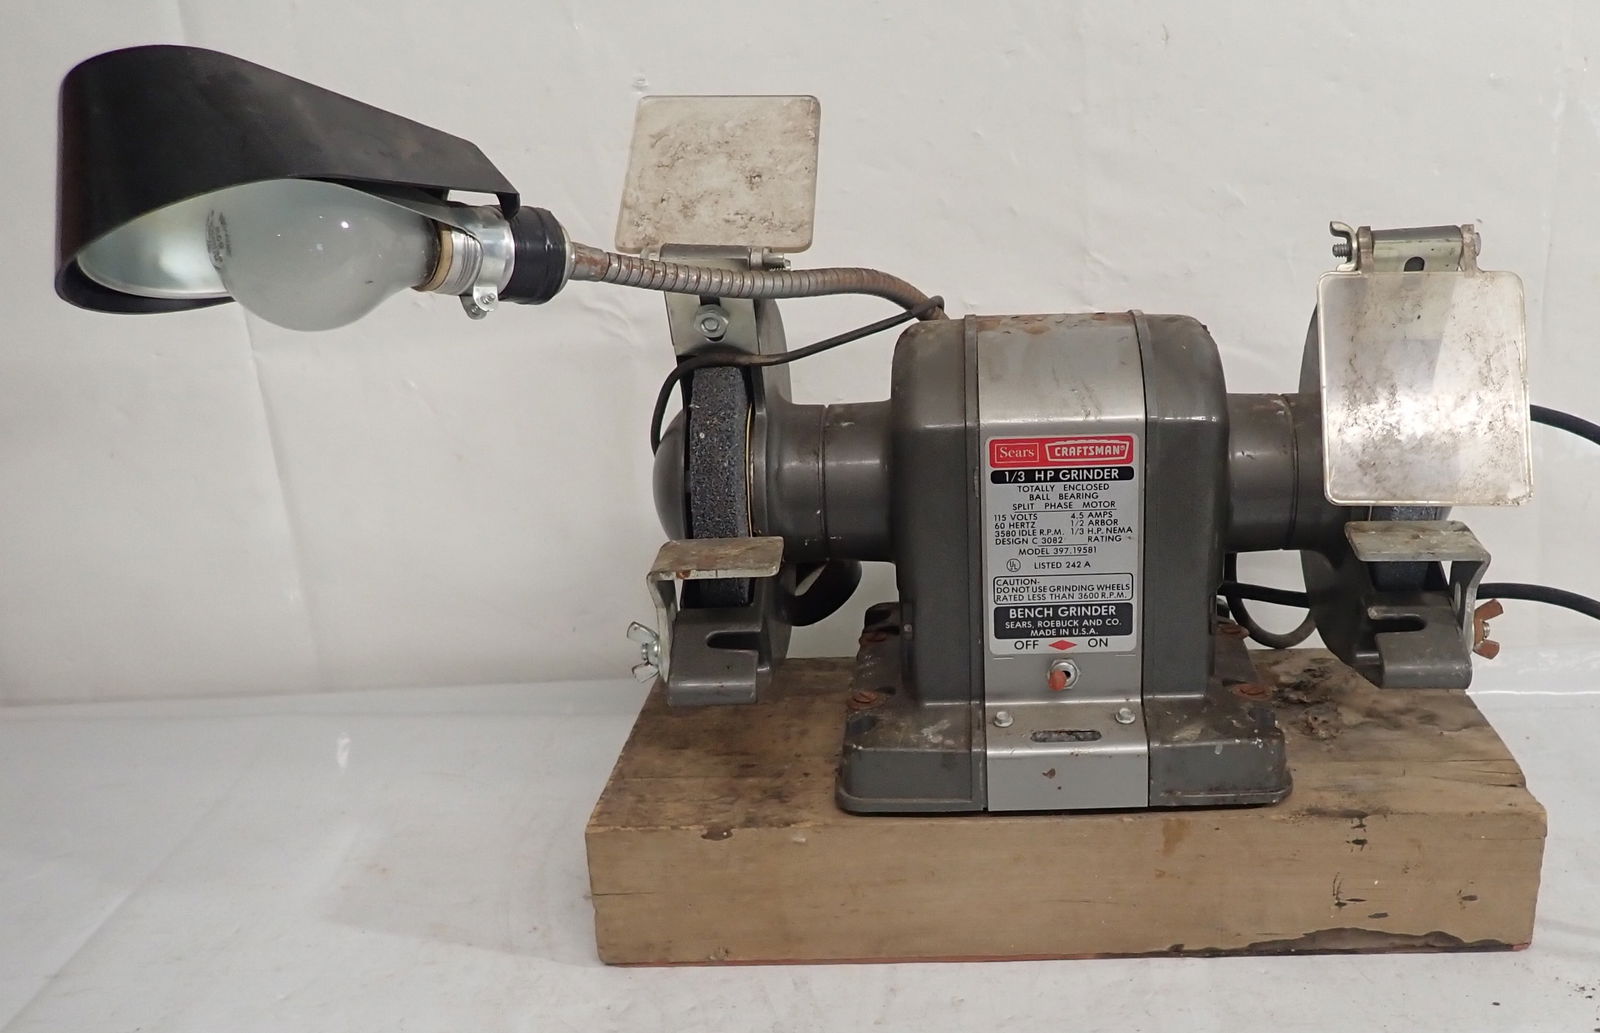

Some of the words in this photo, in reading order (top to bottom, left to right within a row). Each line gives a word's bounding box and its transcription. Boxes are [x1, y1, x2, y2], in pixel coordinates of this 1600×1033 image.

[1000, 447, 1034, 458] Sears
[1005, 471, 1025, 482] 1/3
[1036, 470, 1054, 481] HP
[1059, 469, 1119, 480] GRINDER
[1009, 608, 1052, 619] BENCH
[1058, 606, 1116, 617] GRINDER
[1014, 640, 1039, 650] OFF
[1088, 638, 1108, 648] ON
